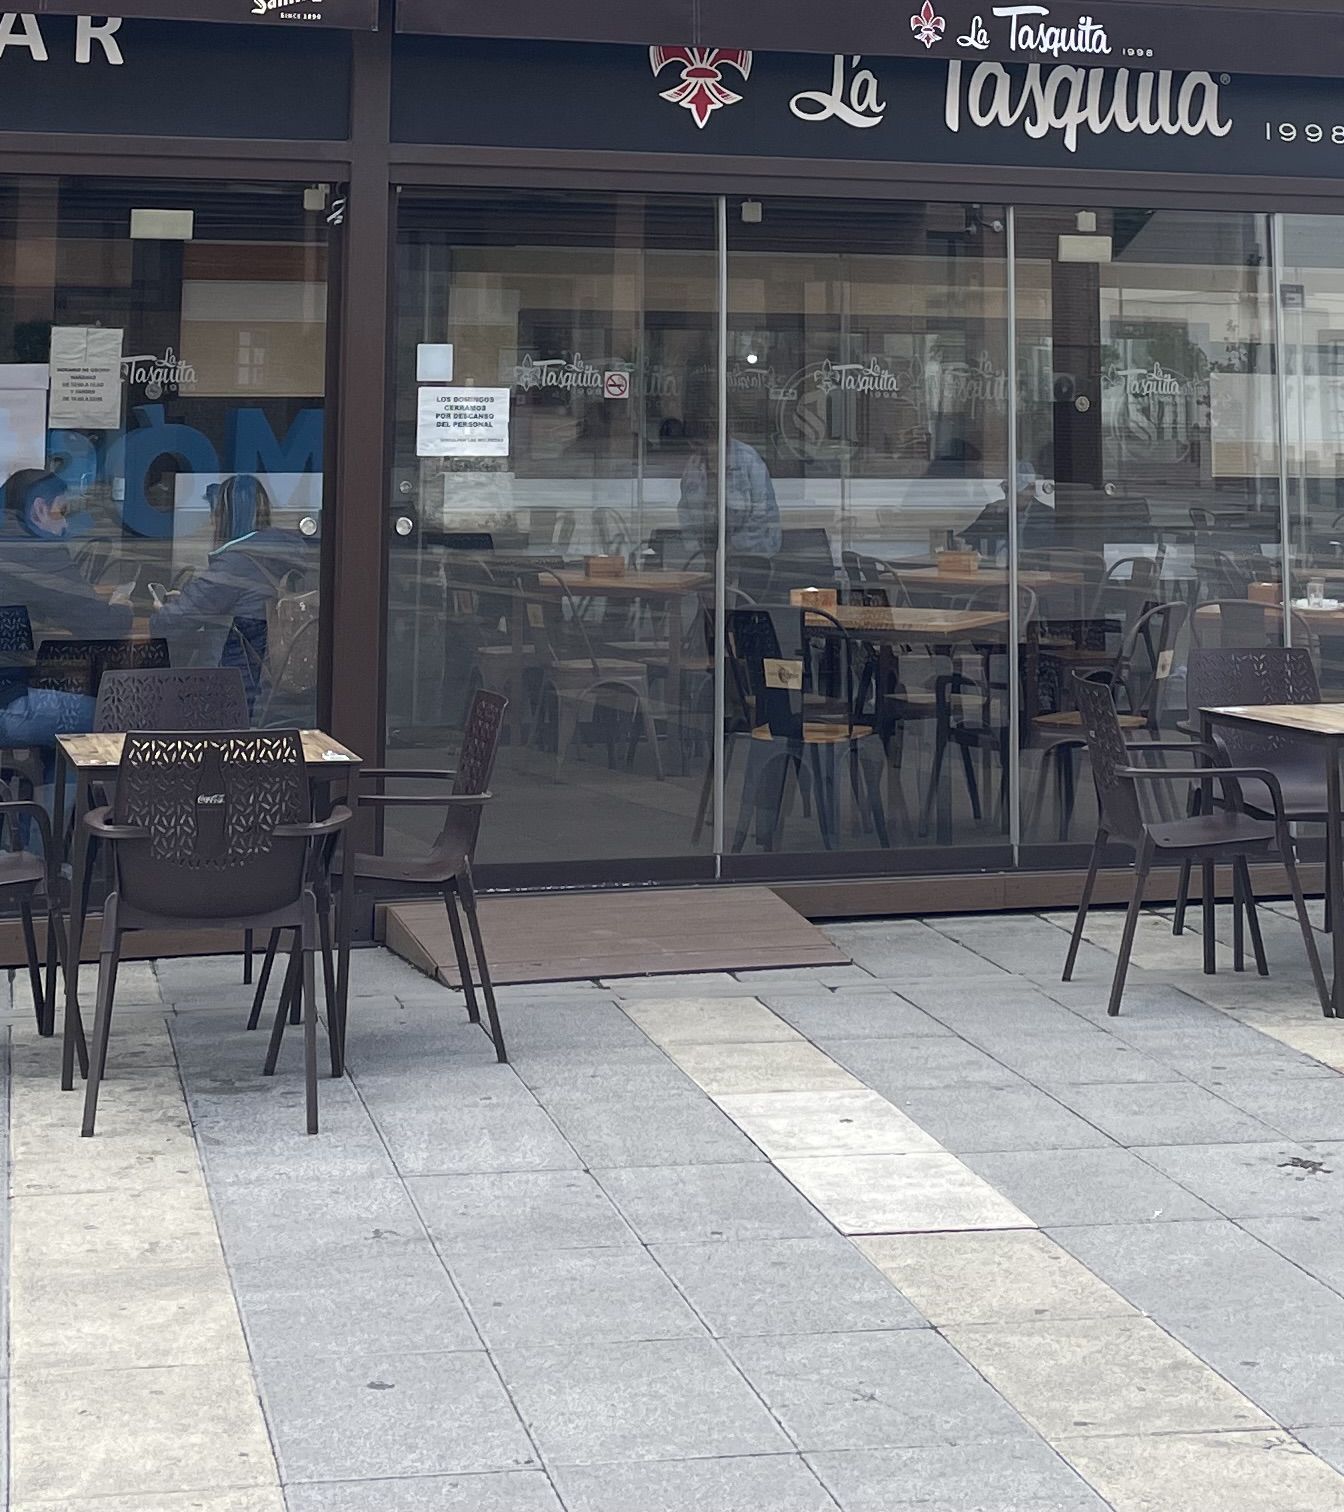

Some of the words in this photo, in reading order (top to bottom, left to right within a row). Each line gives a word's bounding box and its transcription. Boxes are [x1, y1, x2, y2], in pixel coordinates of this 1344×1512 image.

[957, 15, 990, 49] La
[992, 5, 1112, 57] Tasquita
[1122, 47, 1154, 57] 1998
[789, 54, 887, 129] La
[121, 355, 198, 386] Tasquita
[156, 347, 177, 367] La
[533, 359, 603, 391] Tasquita
[832, 364, 899, 395] Tasquita
